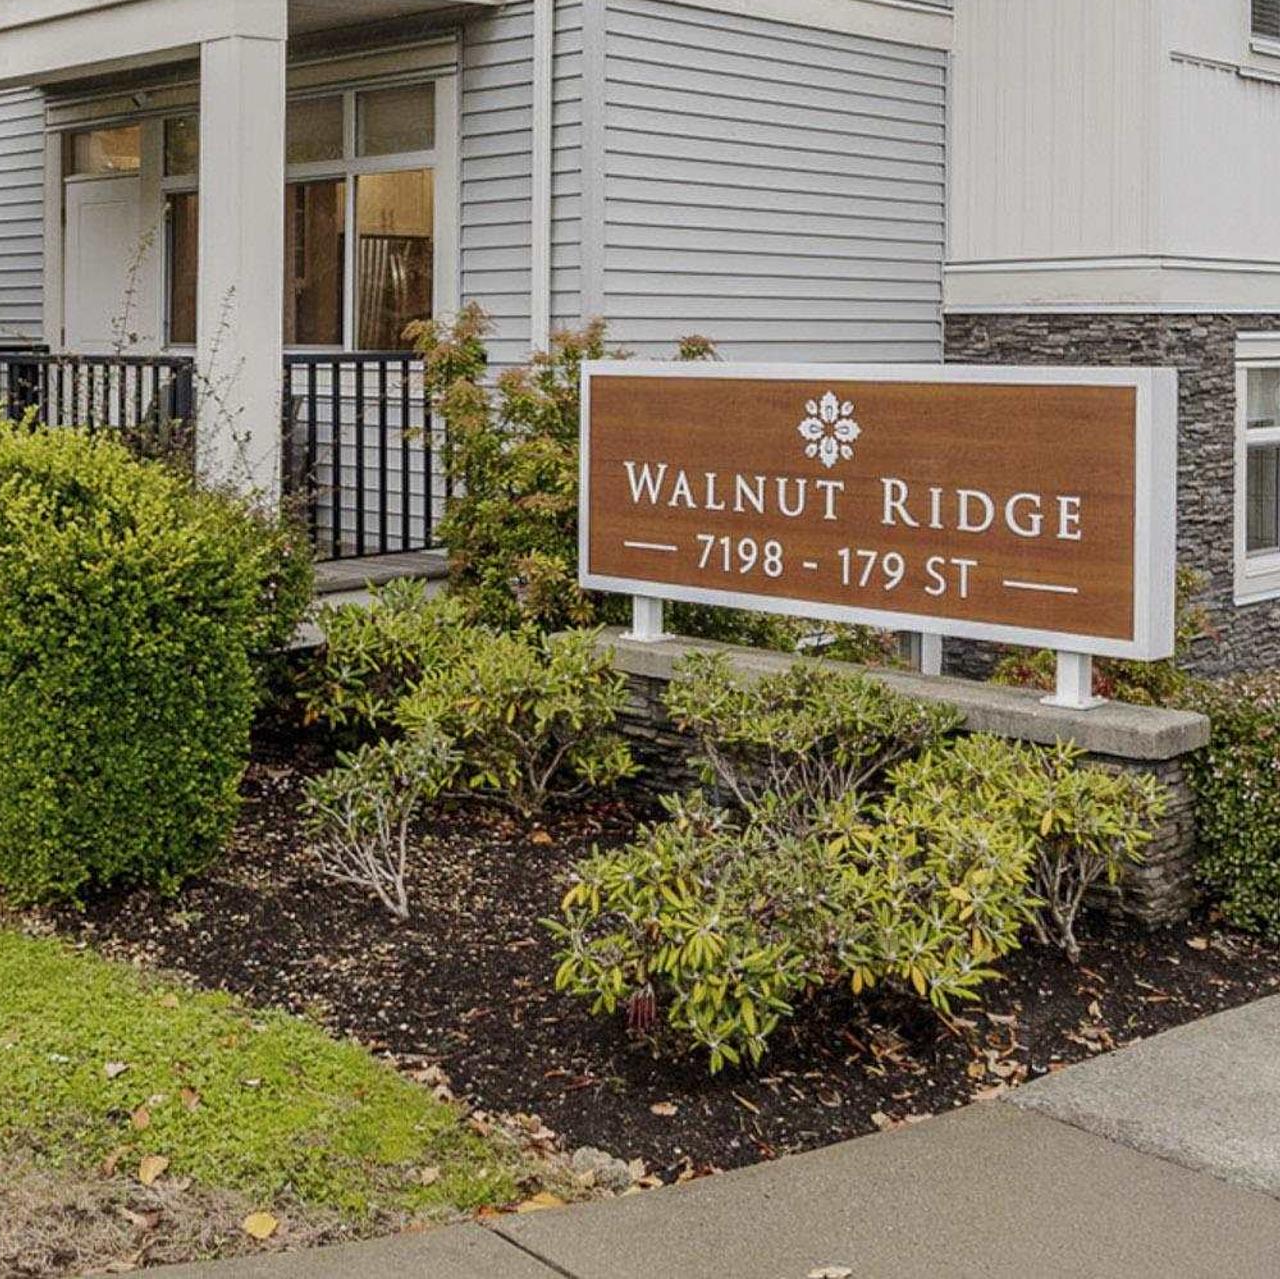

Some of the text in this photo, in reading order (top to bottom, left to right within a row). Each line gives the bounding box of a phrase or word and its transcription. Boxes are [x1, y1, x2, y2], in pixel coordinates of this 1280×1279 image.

[624, 461, 1082, 540] WALNUT RIDGE
[696, 533, 783, 578] 7198
[837, 547, 905, 591] 179
[924, 555, 978, 598] ST
